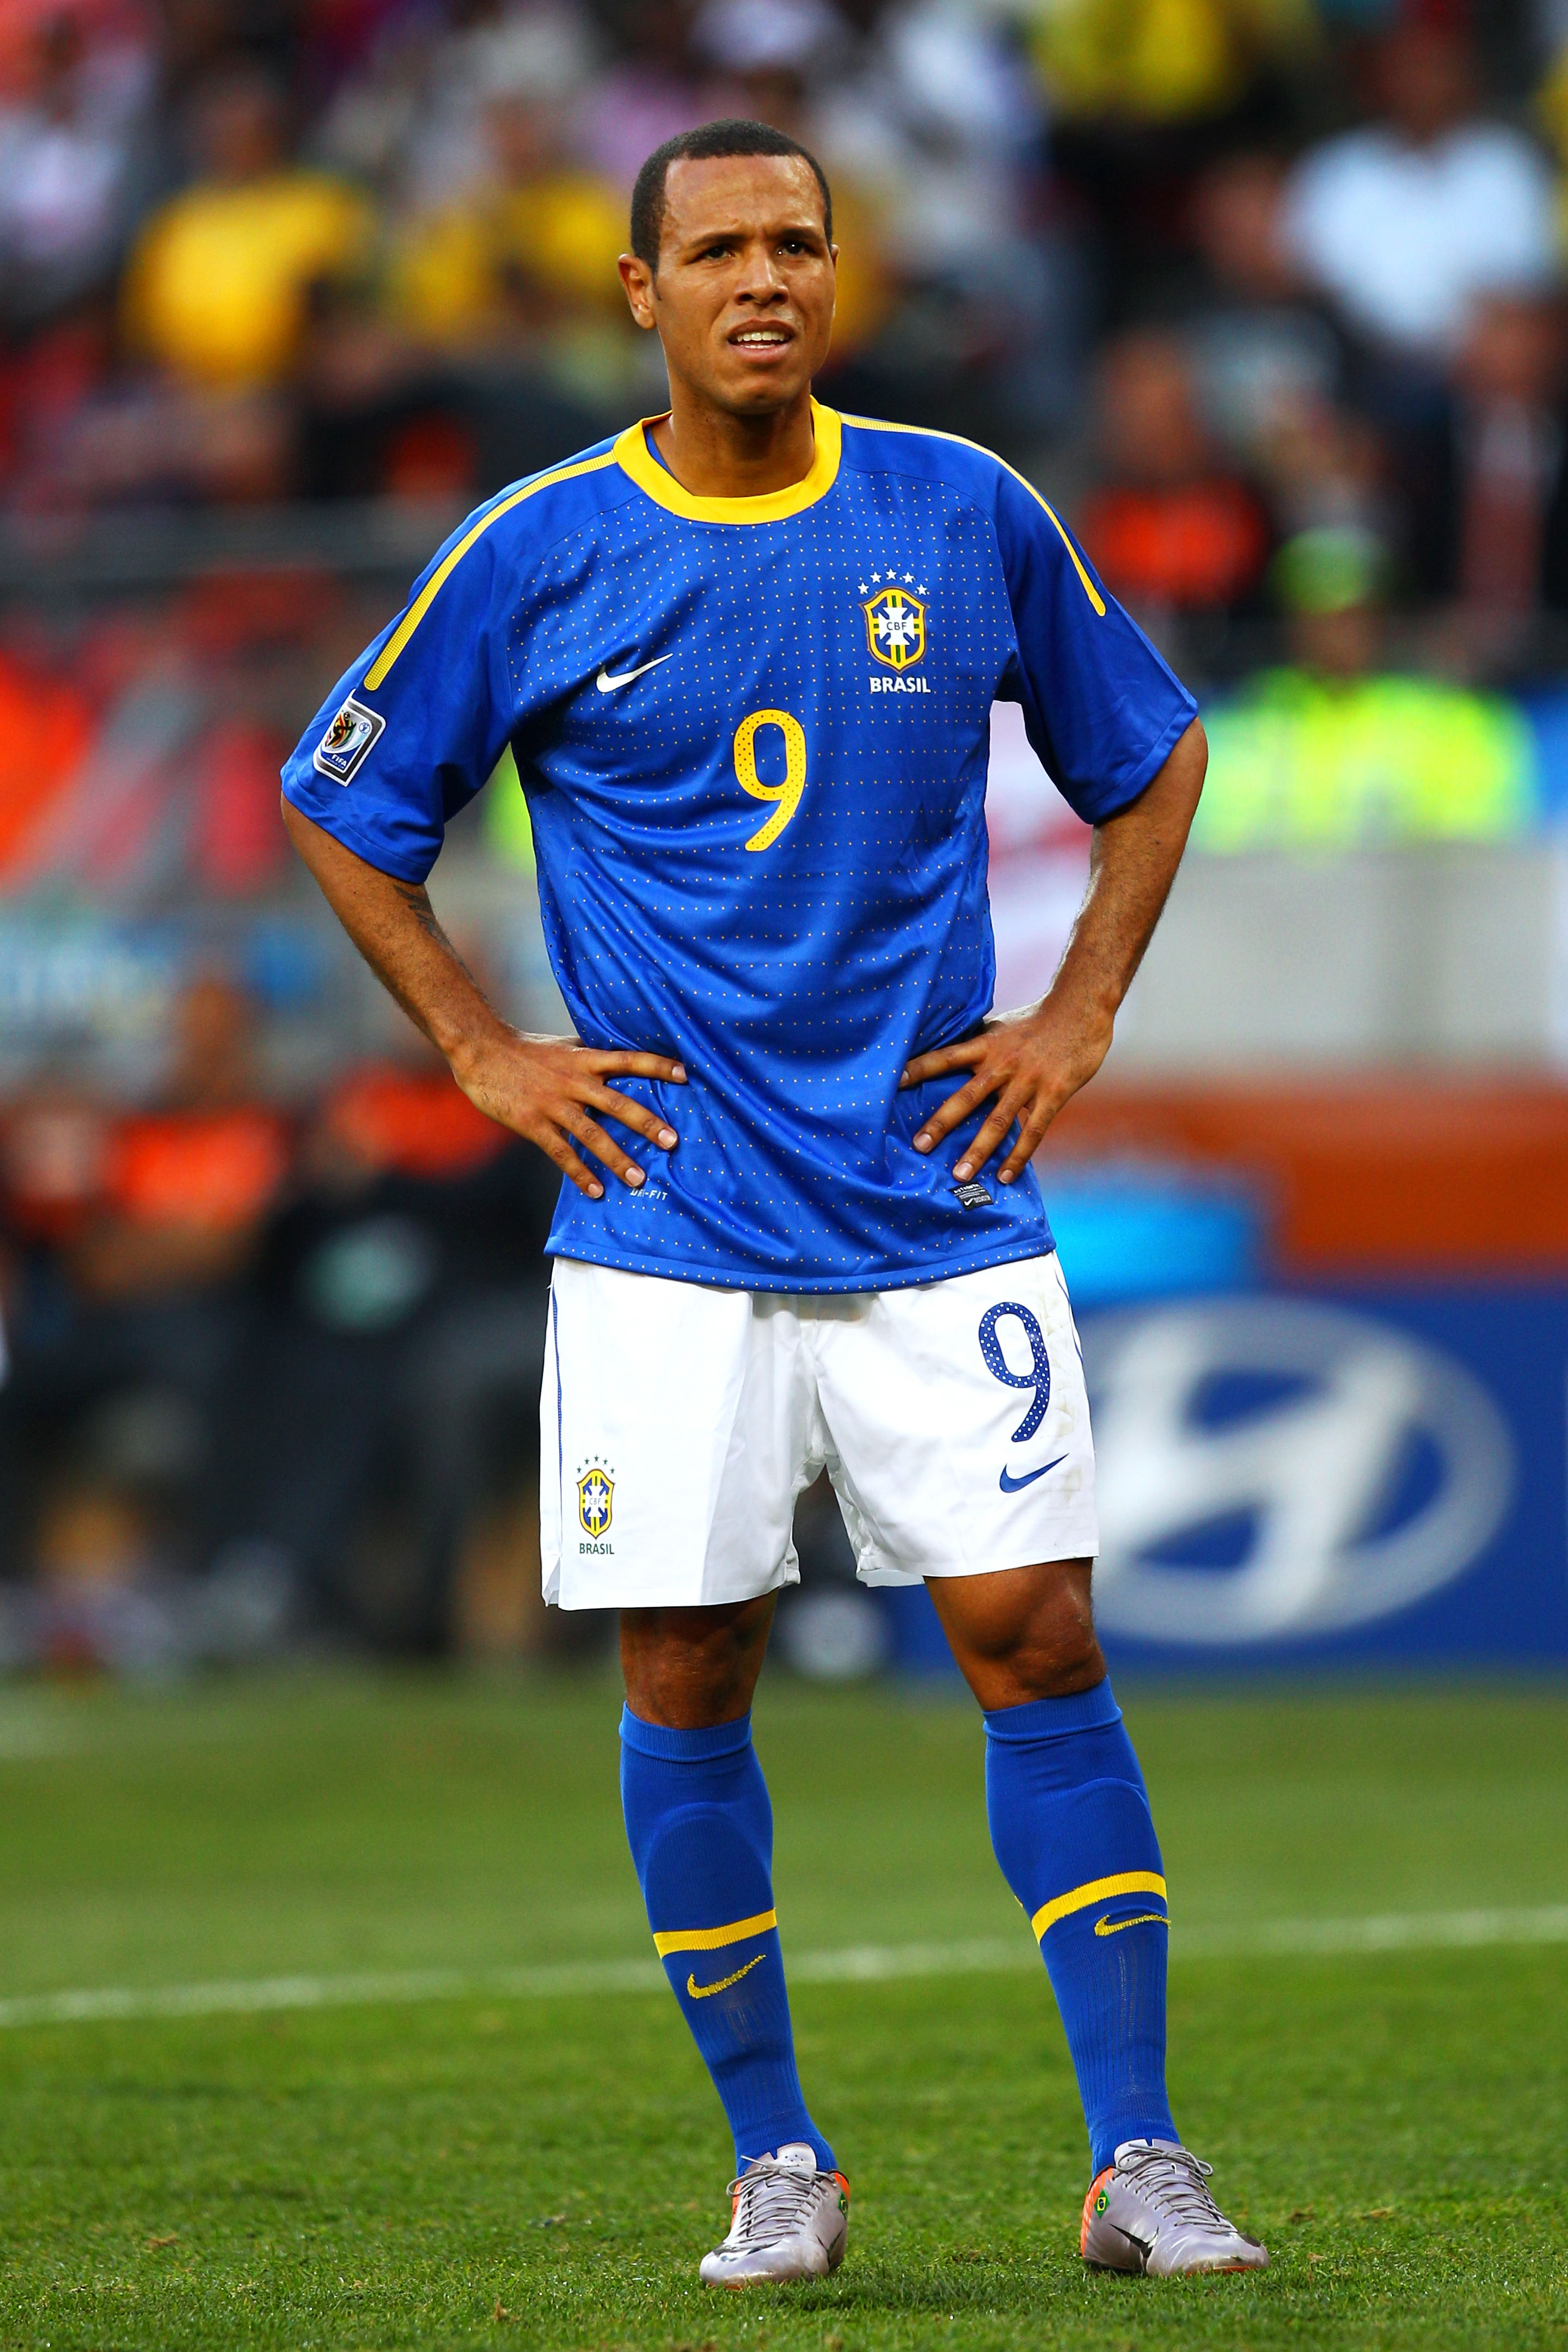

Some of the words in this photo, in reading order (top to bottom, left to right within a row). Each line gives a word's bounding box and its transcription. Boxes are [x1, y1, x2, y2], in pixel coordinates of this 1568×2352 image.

[886, 622, 907, 630] CBF
[869, 677, 931, 693] BRASIL
[331, 754, 347, 767] FIFA
[733, 708, 807, 852] 9
[978, 1302, 1051, 1442] 9
[579, 1543, 615, 1555] BRASIL
